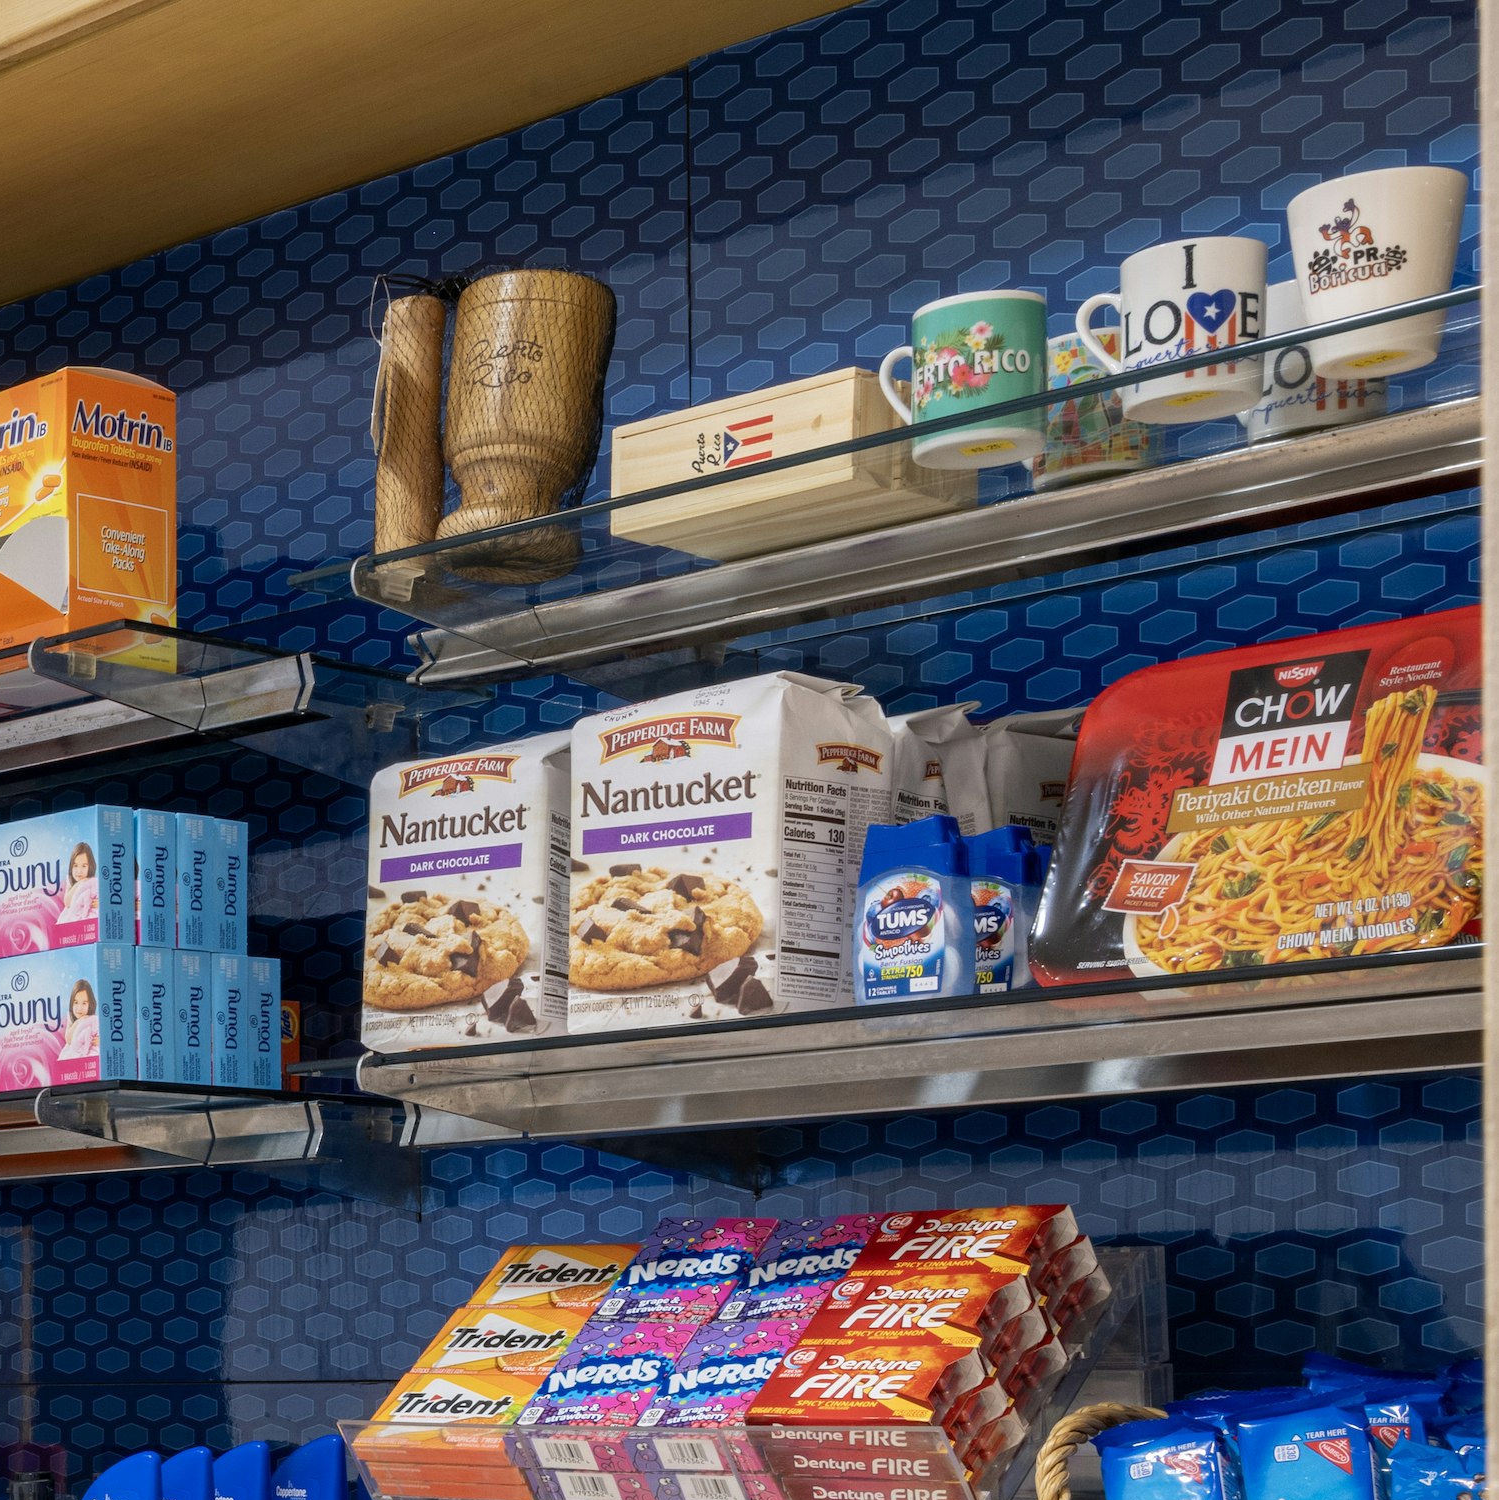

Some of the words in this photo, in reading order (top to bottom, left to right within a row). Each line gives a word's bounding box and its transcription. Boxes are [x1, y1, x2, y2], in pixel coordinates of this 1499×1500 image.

[1182, 245, 1197, 289] I
[1310, 261, 1389, 294] Boricua
[468, 339, 543, 365] Puerto
[974, 349, 1030, 374] RICO
[469, 363, 532, 387] Rico
[72, 399, 163, 450] Motrin
[163, 439, 173, 452] IB
[72, 436, 108, 452] Ibuprofen
[110, 443, 135, 458] Tablets
[692, 432, 705, 474] Puerto
[707, 433, 721, 466] Rico
[101, 525, 146, 546] Convenient
[101, 540, 145, 563] Take-Along
[112, 556, 135, 572] Packs
[1278, 666, 1318, 681] NISSIN
[1379, 676, 1404, 687] Style
[1405, 670, 1443, 683] Noodles
[1389, 660, 1442, 677] Restaurant
[1234, 683, 1352, 729] CHOW
[611, 720, 687, 753] PEPPERIDGE
[689, 716, 726, 738] FARM
[1229, 732, 1332, 774] MEIN
[580, 770, 757, 818] Nantucket
[785, 778, 824, 794] Nutrition
[827, 784, 847, 797] Facts
[1176, 787, 1250, 816] Teriyaki
[1252, 777, 1332, 803] Chicken
[1333, 779, 1365, 793] Flavor
[1195, 812, 1220, 825] With
[1222, 809, 1251, 822] Other
[1253, 803, 1294, 817] Natural
[1296, 798, 1336, 813] Flavors
[380, 803, 528, 848] Nantucket
[620, 831, 650, 845] DARK
[652, 824, 715, 842] CHOCOLATE
[784, 826, 815, 840] Calories
[828, 829, 845, 844] 130
[110, 843, 126, 905] Downy
[1130, 872, 1180, 887] SAVORY
[1126, 886, 1167, 899] SAUCE
[877, 911, 928, 930] TUMS
[875, 942, 930, 961] Smoothies
[881, 967, 905, 976] EXTRA
[906, 965, 923, 978] 750
[915, 1217, 1018, 1235] Dentyne
[888, 1233, 1010, 1261] FIRE
[499, 1262, 618, 1284] Trident
[893, 1261, 922, 1270] SPICY
[924, 1260, 976, 1269] CINNAMON
[398, 1392, 512, 1416] Trident
[1305, 1430, 1325, 1440] TEAR
[1327, 1428, 1347, 1438] HERE
[813, 1486, 885, 1500] Dentyne
